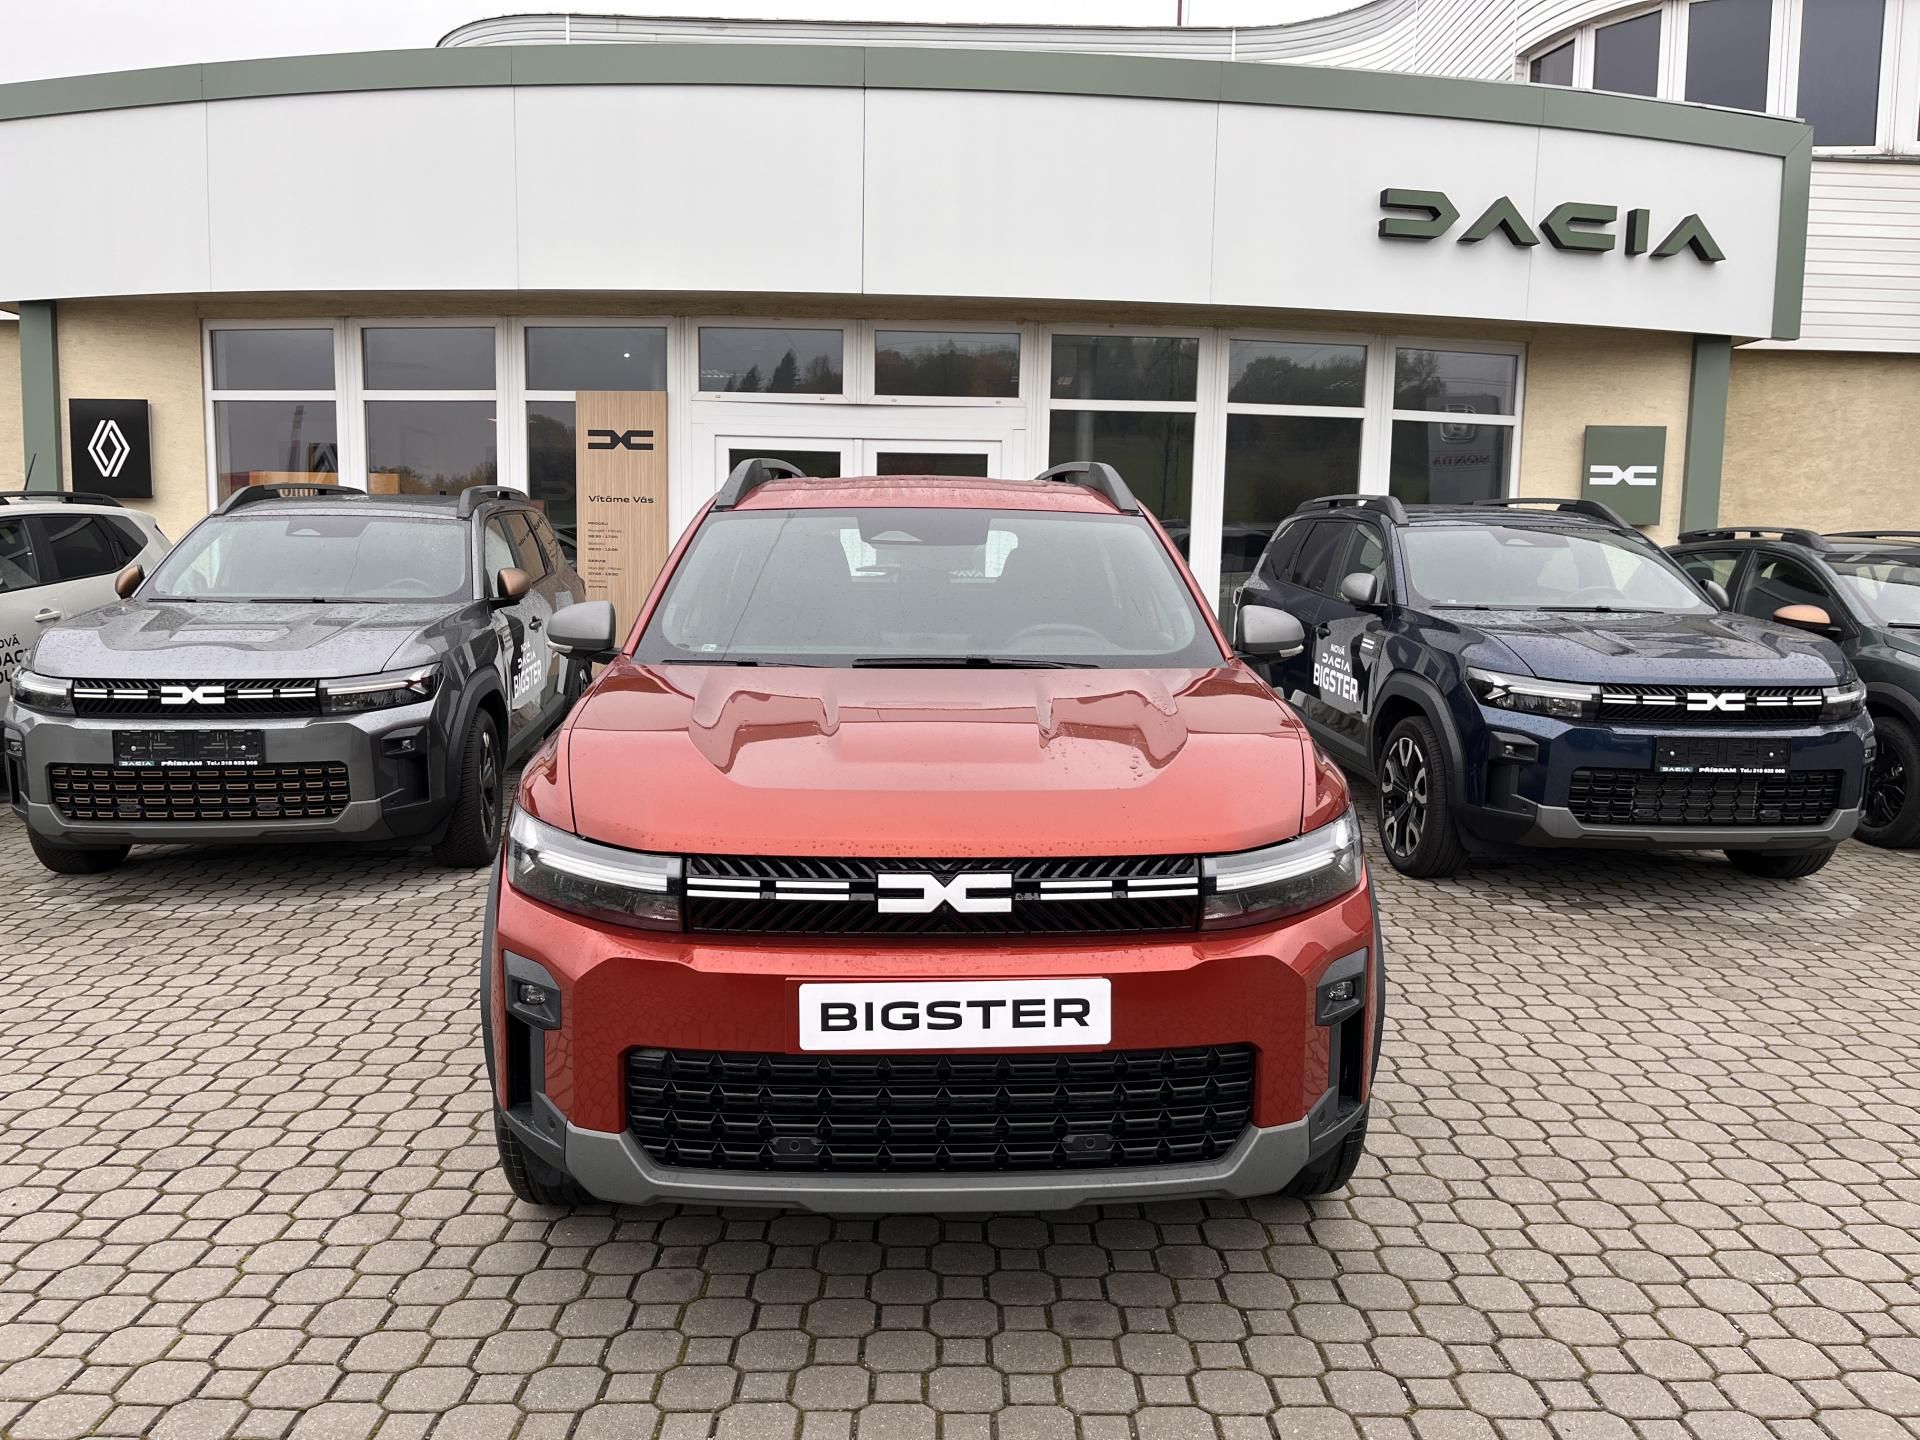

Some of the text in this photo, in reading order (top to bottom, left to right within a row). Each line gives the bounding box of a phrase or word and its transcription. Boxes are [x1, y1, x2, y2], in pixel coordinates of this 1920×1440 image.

[1378, 188, 1726, 264] DACIA
[588, 495, 630, 503] Vítáme
[517, 650, 536, 669] DACIA
[1321, 652, 1350, 672] DACIA
[1330, 643, 1345, 656] NOVÁ
[513, 659, 542, 699] BIGSTER
[1313, 663, 1357, 703] BIGSTER
[820, 997, 1090, 1031] BIGSTER
